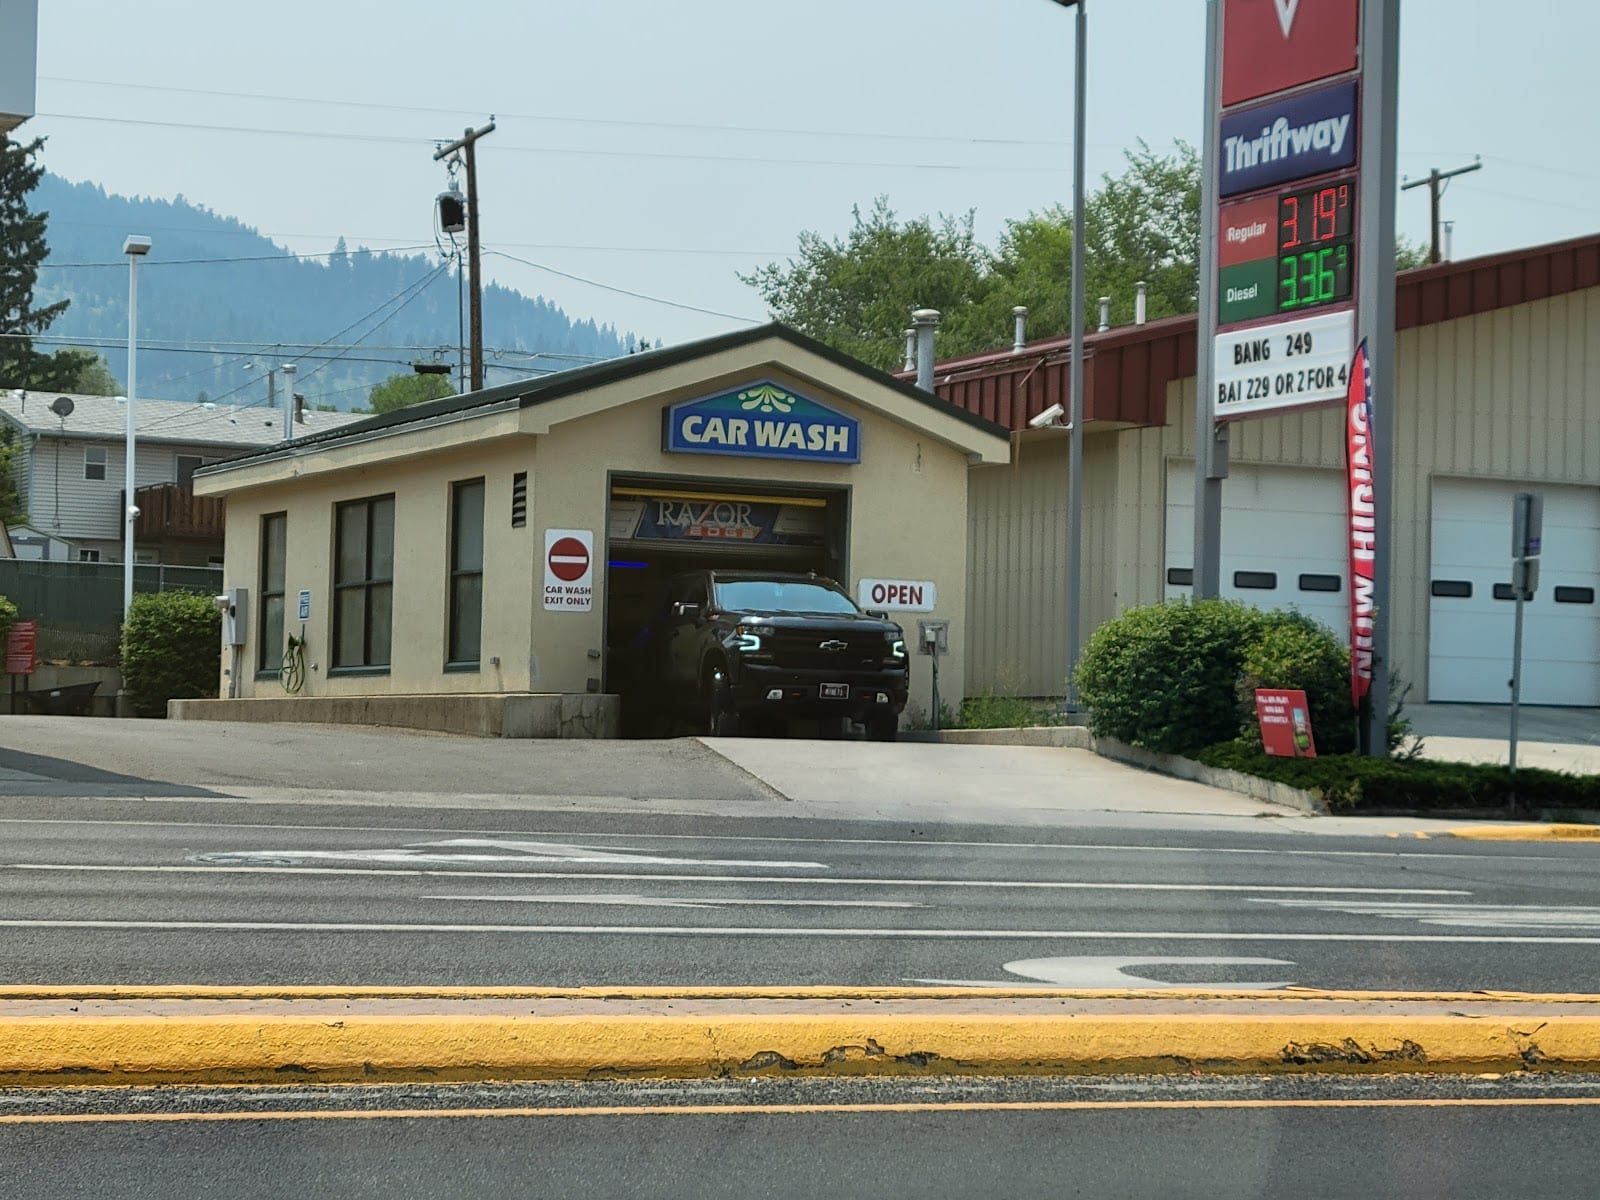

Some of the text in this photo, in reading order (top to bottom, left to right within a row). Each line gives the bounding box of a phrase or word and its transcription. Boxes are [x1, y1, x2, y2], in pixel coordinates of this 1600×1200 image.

[1225, 114, 1350, 172] Thriftway
[1227, 222, 1267, 242] Regular
[1227, 283, 1258, 302] Diesel
[1234, 331, 1312, 365] BANG 249
[1246, 375, 1270, 399] 229
[1275, 373, 1294, 395] OR
[1338, 363, 1347, 386] 4
[681, 415, 849, 452] CAR WASH
[656, 501, 755, 527] RAZOR
[545, 586, 591, 595] CAR WASH
[545, 596, 591, 605] EXIT ONLY
[871, 583, 923, 605] OPEN
